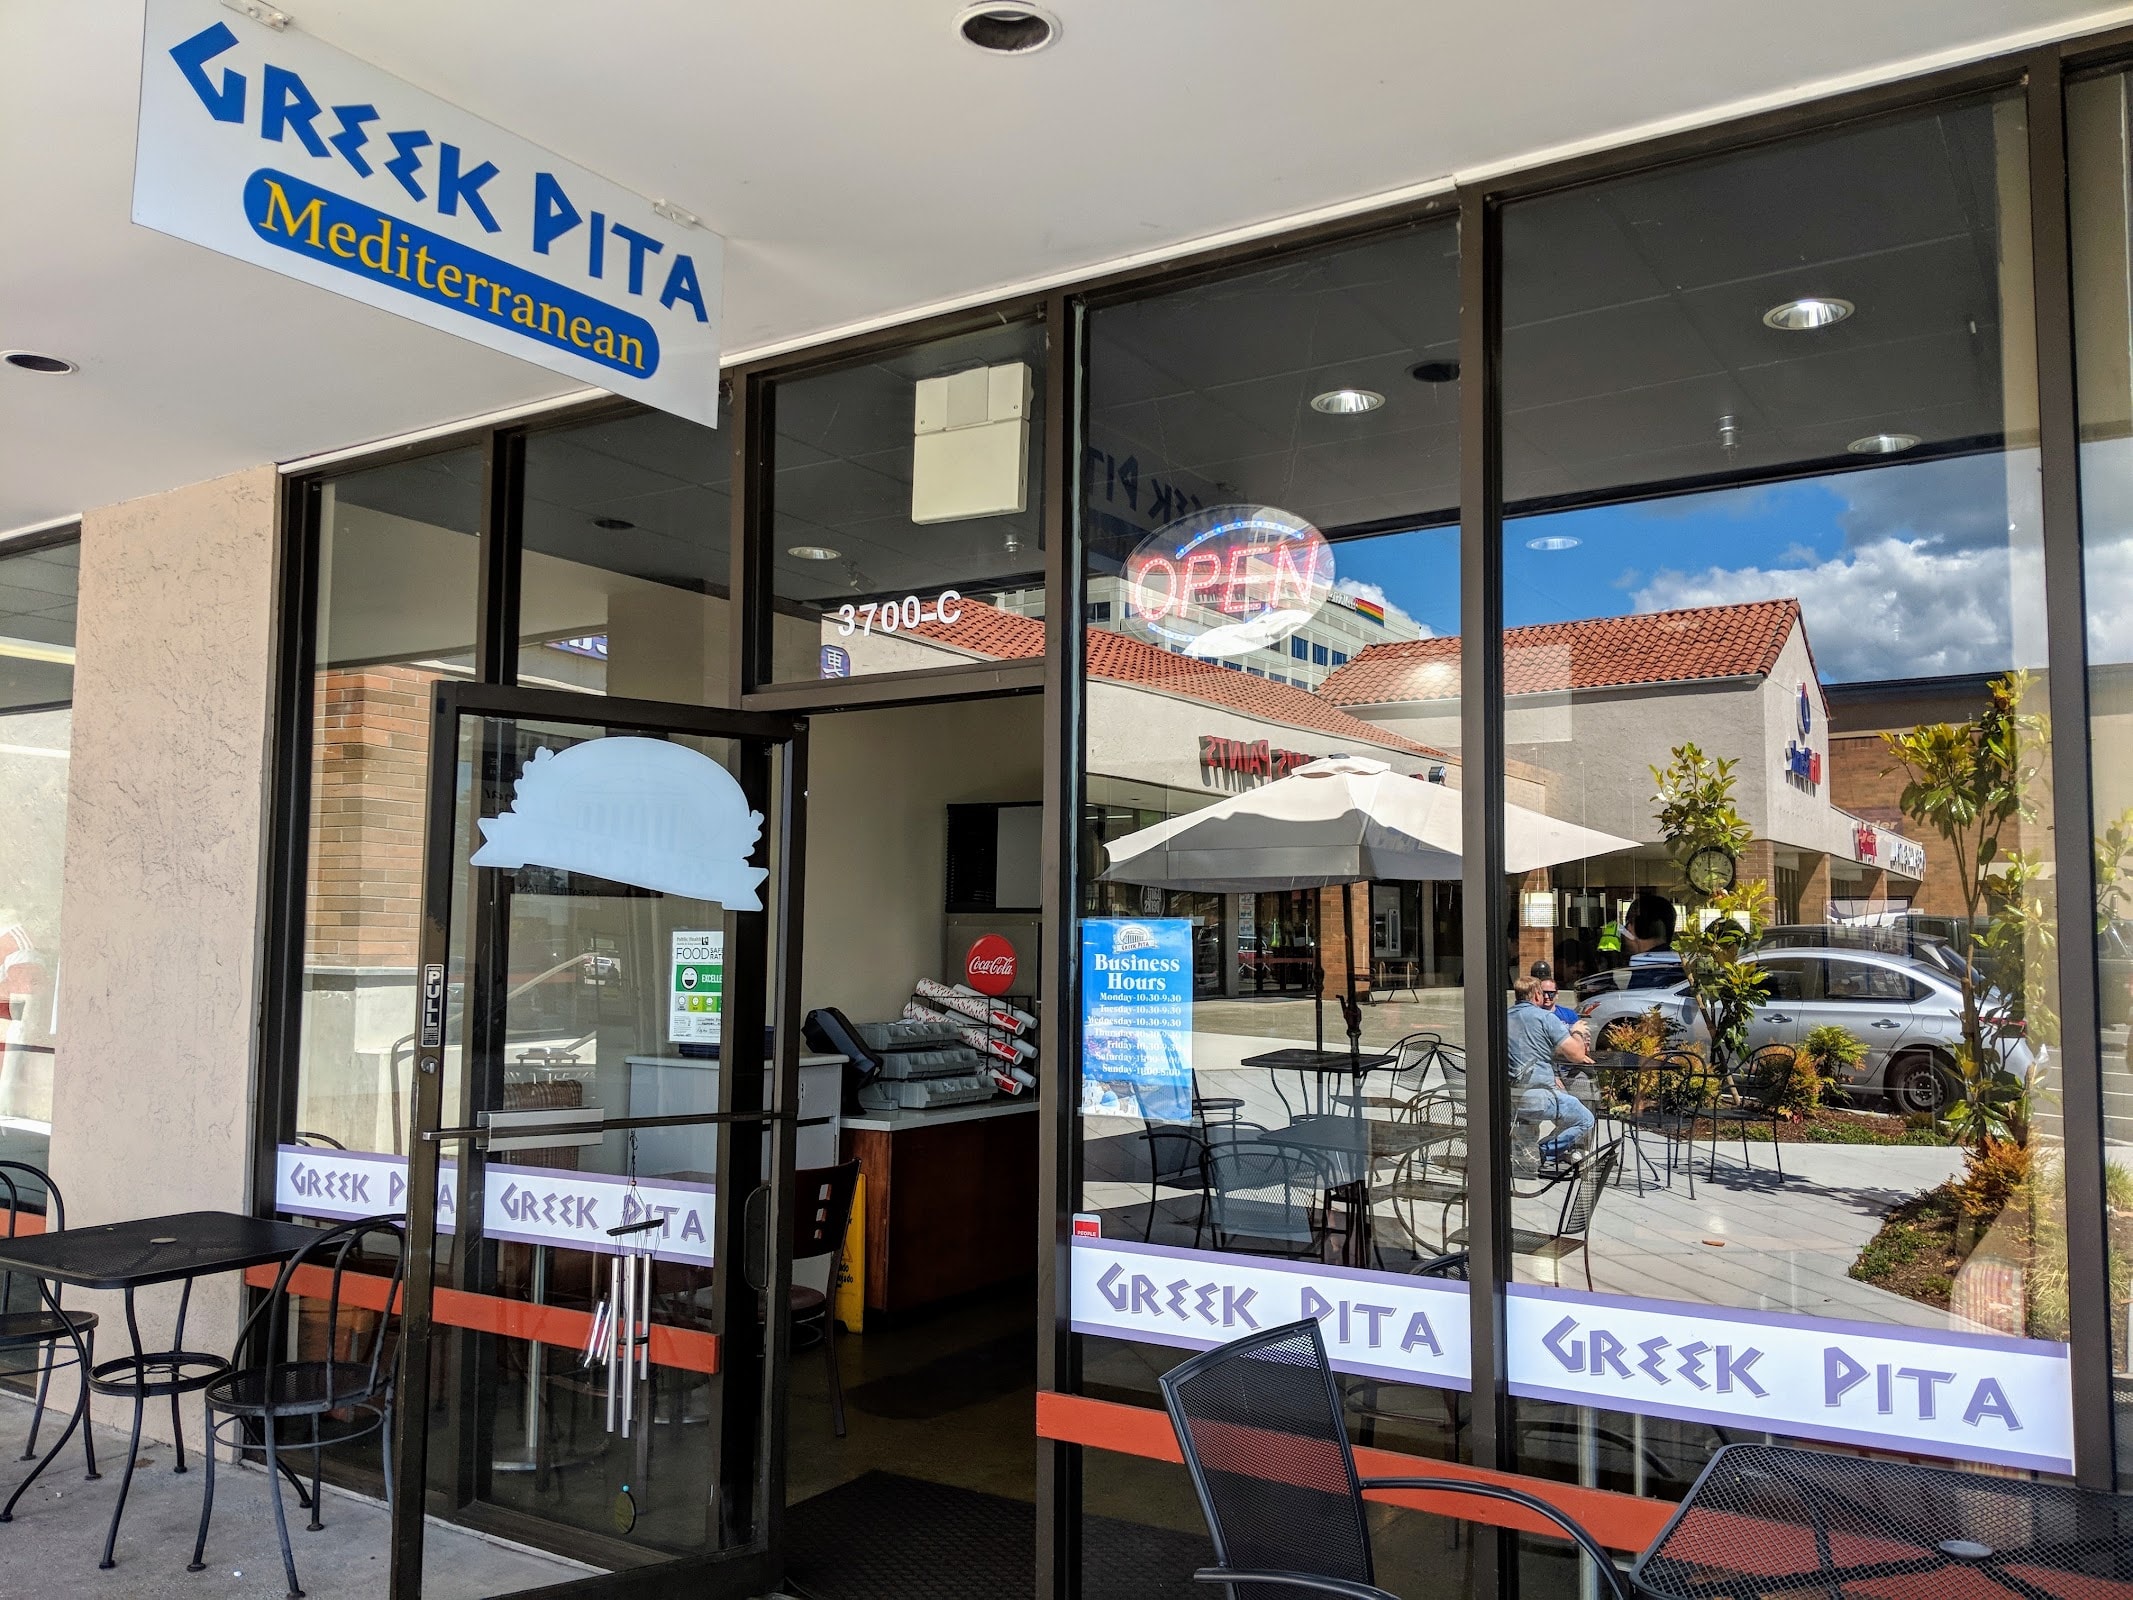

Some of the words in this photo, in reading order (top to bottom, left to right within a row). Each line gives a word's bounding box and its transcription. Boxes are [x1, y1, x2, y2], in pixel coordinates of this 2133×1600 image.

[169, 21, 502, 234] GREEK
[533, 172, 709, 324] PITA
[258, 179, 646, 371] Mediterranean
[1134, 540, 1319, 621] OPEN
[838, 589, 961, 637] 3700-C
[676, 947, 710, 960] FOOD
[968, 956, 1016, 975] Coca-Cola
[1094, 954, 1180, 972] Business
[1107, 972, 1167, 991] Hours
[426, 971, 440, 1027] PULL
[290, 1162, 370, 1204] GREEK
[500, 1182, 599, 1231] GREEK
[623, 1194, 707, 1244] PITA
[1096, 1262, 1262, 1331] GREEK
[1300, 1286, 1444, 1357] PITA
[1541, 1314, 1770, 1398] GREEK
[1823, 1346, 2023, 1432] PITA
